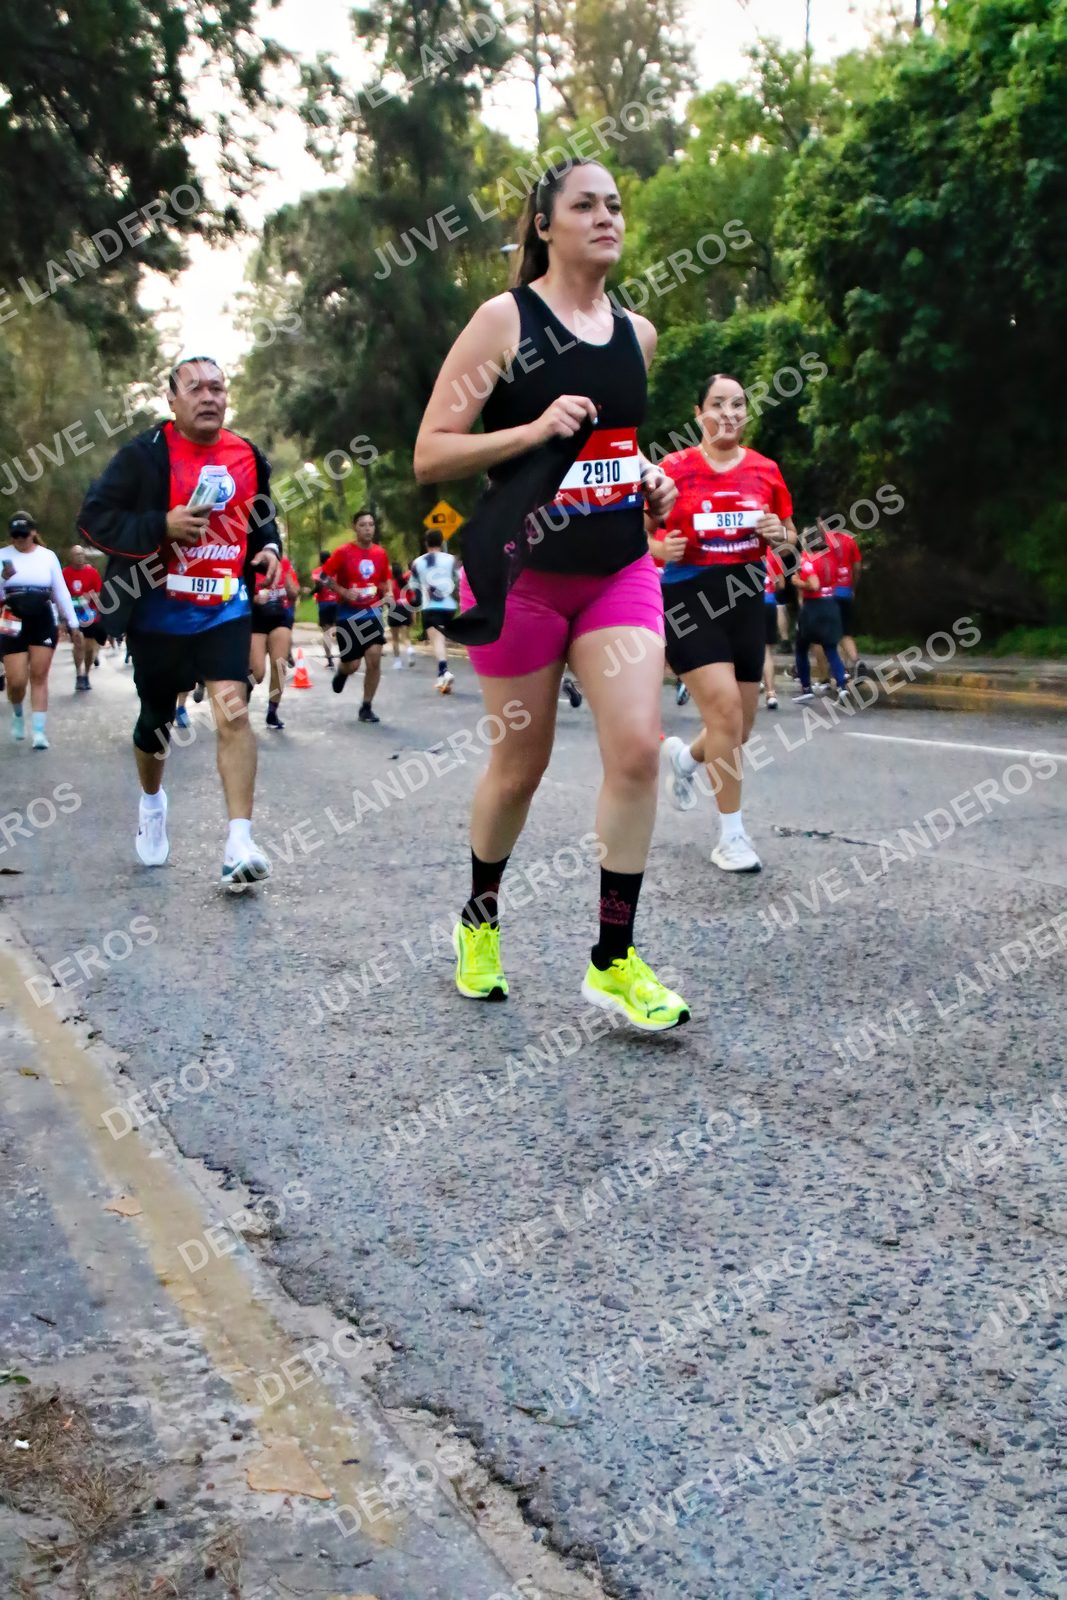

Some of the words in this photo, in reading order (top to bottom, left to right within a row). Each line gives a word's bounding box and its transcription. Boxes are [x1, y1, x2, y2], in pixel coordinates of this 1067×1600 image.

[582, 460, 620, 485] 2910
[716, 512, 744, 527] 3612
[191, 578, 218, 592] 1917
